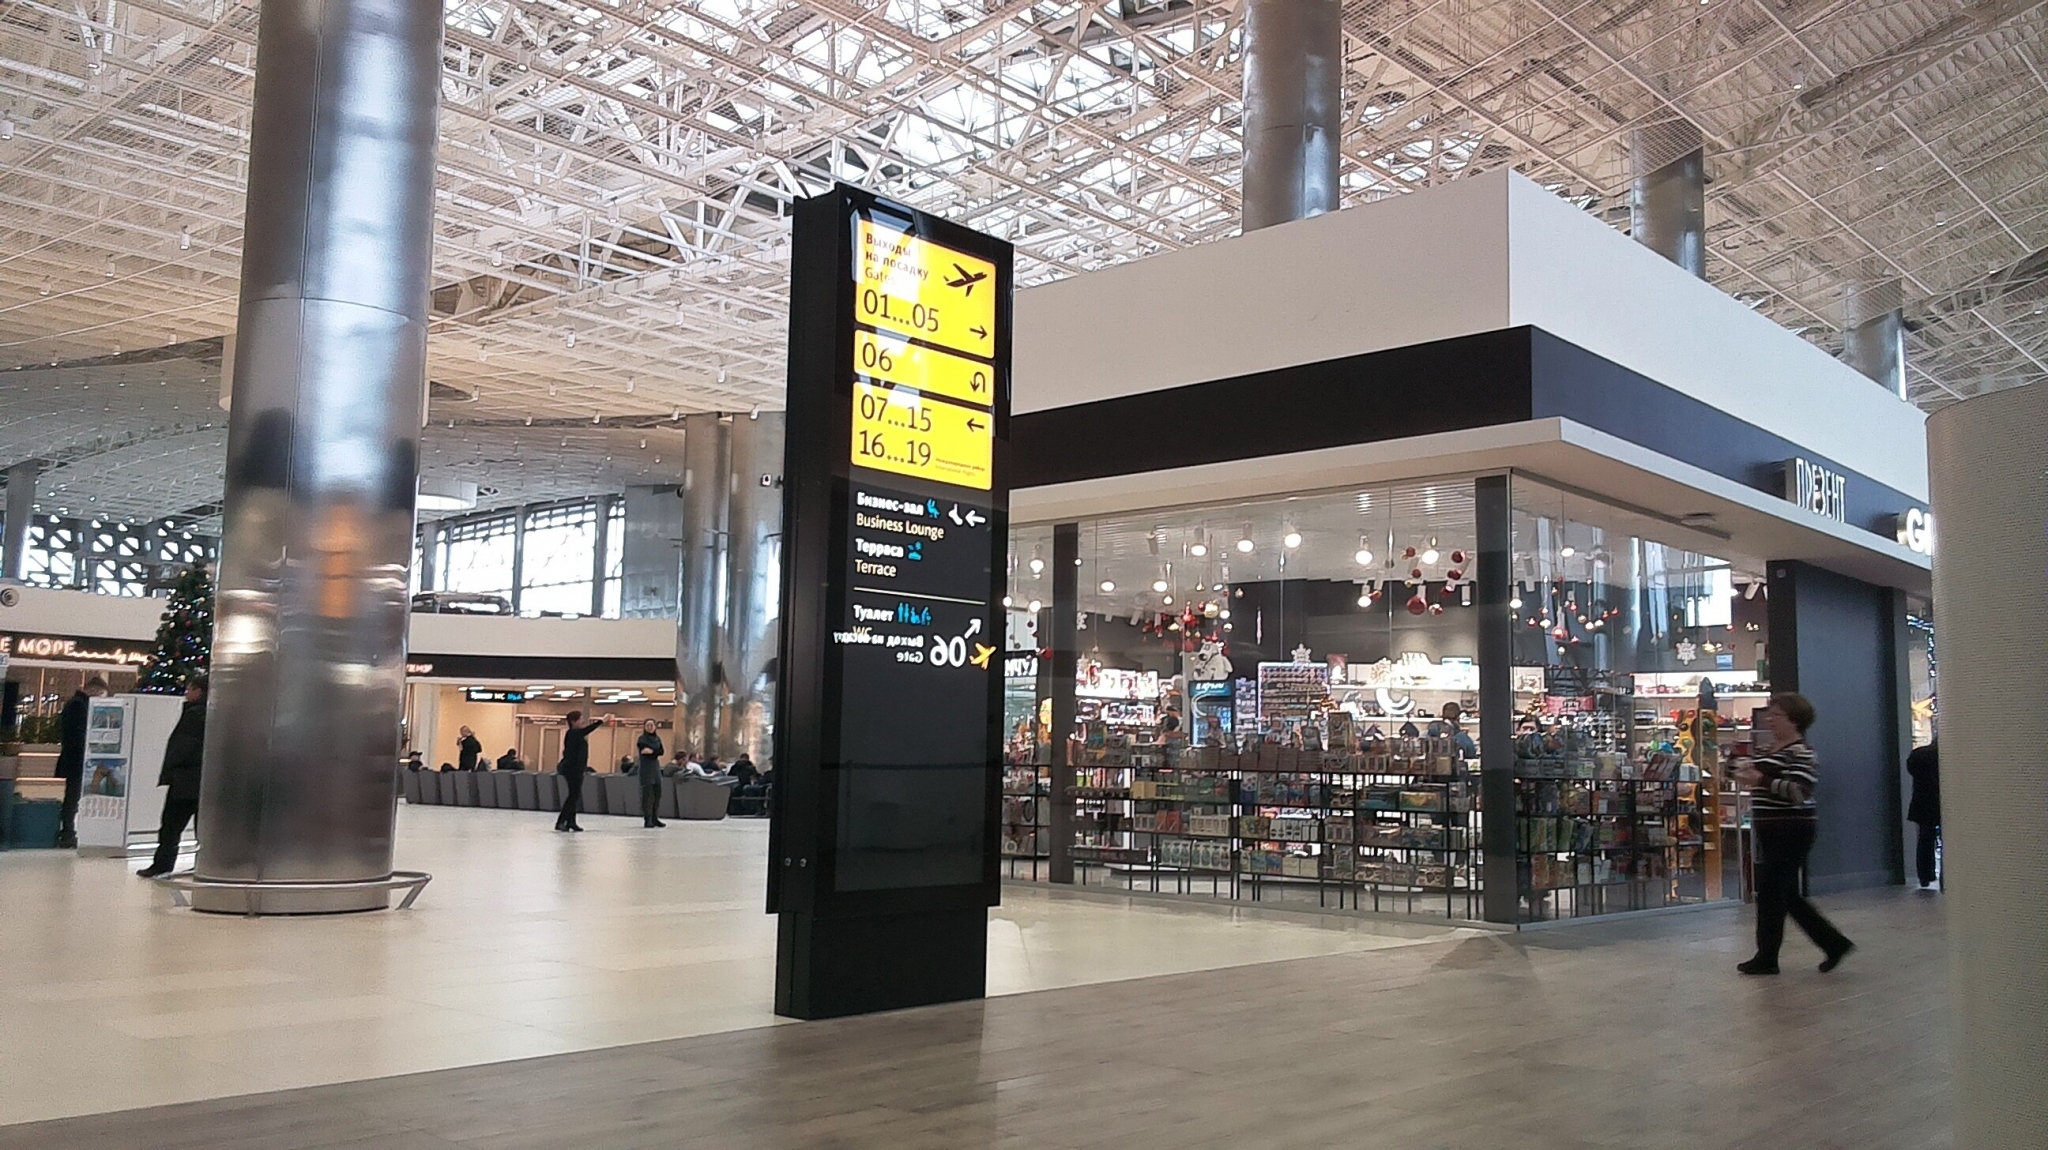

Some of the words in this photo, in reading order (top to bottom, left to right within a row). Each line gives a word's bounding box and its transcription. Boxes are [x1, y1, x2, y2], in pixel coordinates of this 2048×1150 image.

[866, 232, 911, 257] Выходы
[865, 252, 880, 267] на
[883, 256, 929, 280] посадку
[862, 342, 893, 372] 06
[1796, 458, 1845, 523] ПРЕЗЕНТ
[856, 492, 924, 516] Бизнес-зал
[856, 513, 903, 533] Business
[905, 521, 944, 541] Lounge
[855, 538, 904, 558] Терраса
[855, 559, 897, 577] Terrace
[853, 604, 894, 622] Туалет
[18, 638, 77, 656] МОРЕ
